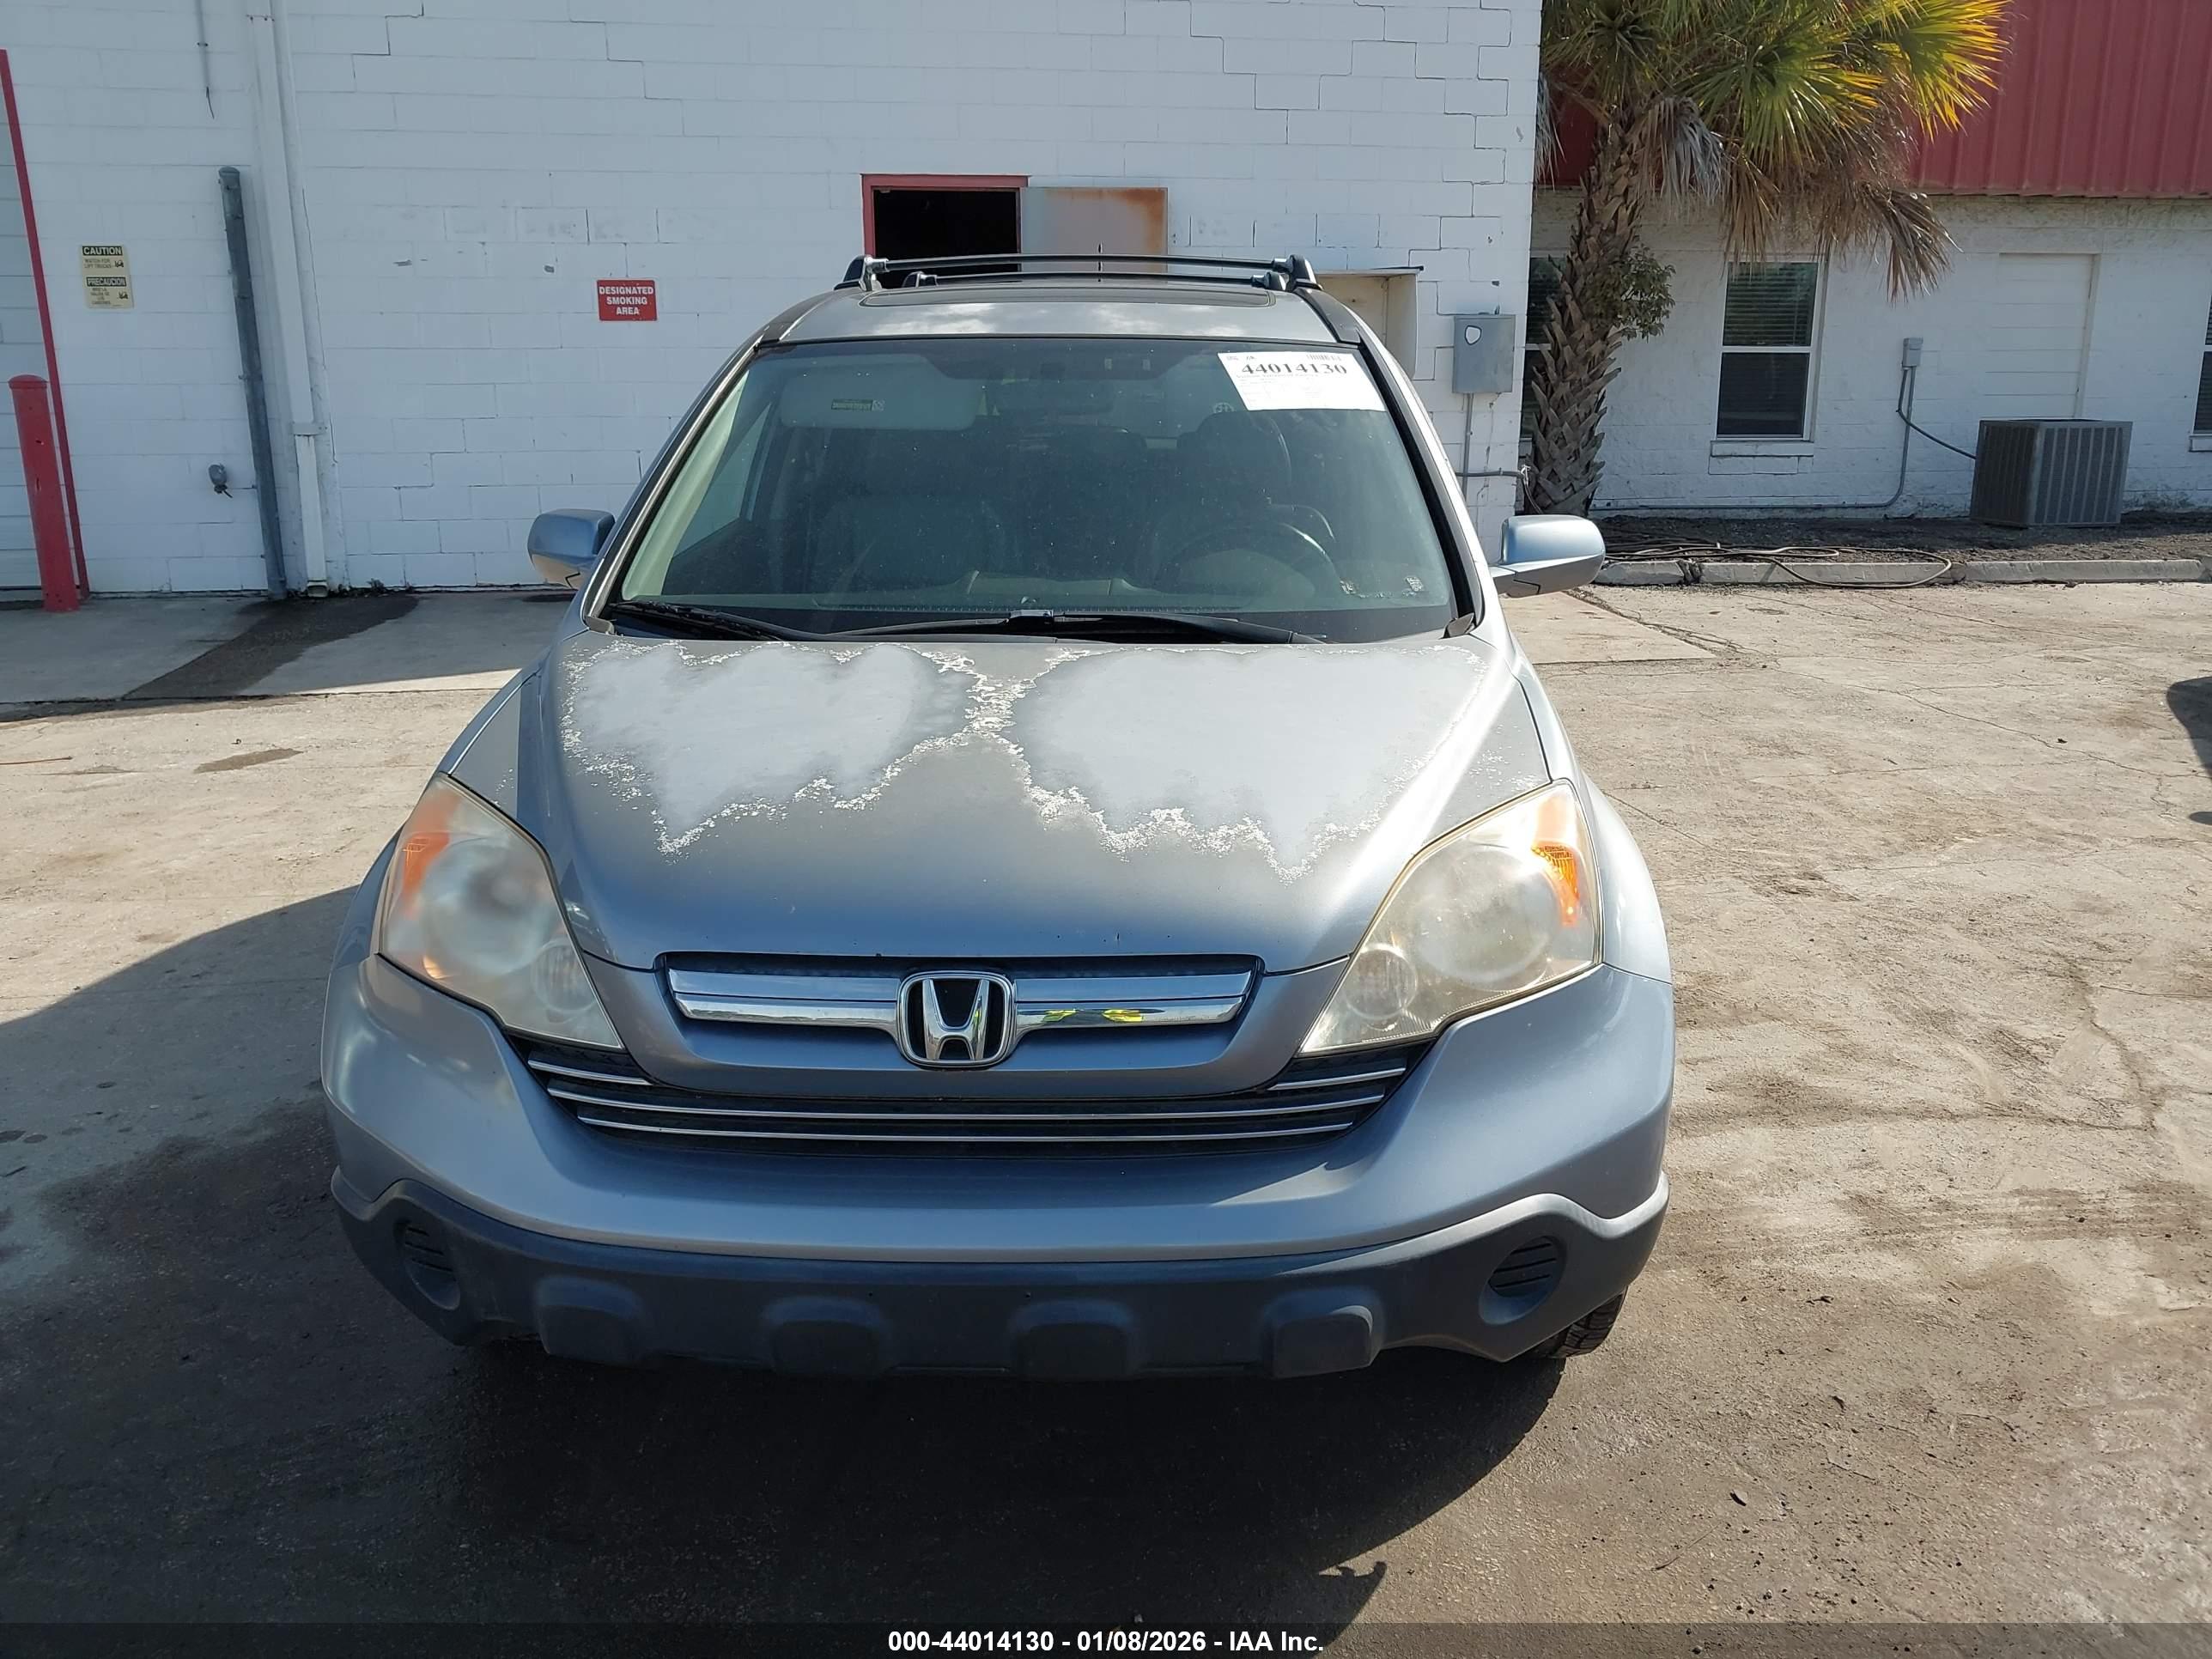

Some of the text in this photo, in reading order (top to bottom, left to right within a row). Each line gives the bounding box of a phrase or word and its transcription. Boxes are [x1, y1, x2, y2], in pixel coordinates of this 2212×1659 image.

[83, 246, 122, 255] CAUTION
[599, 286, 654, 295] DESIGNATED
[606, 296, 647, 305] SMOKING
[1241, 363, 1347, 374] 44014130
